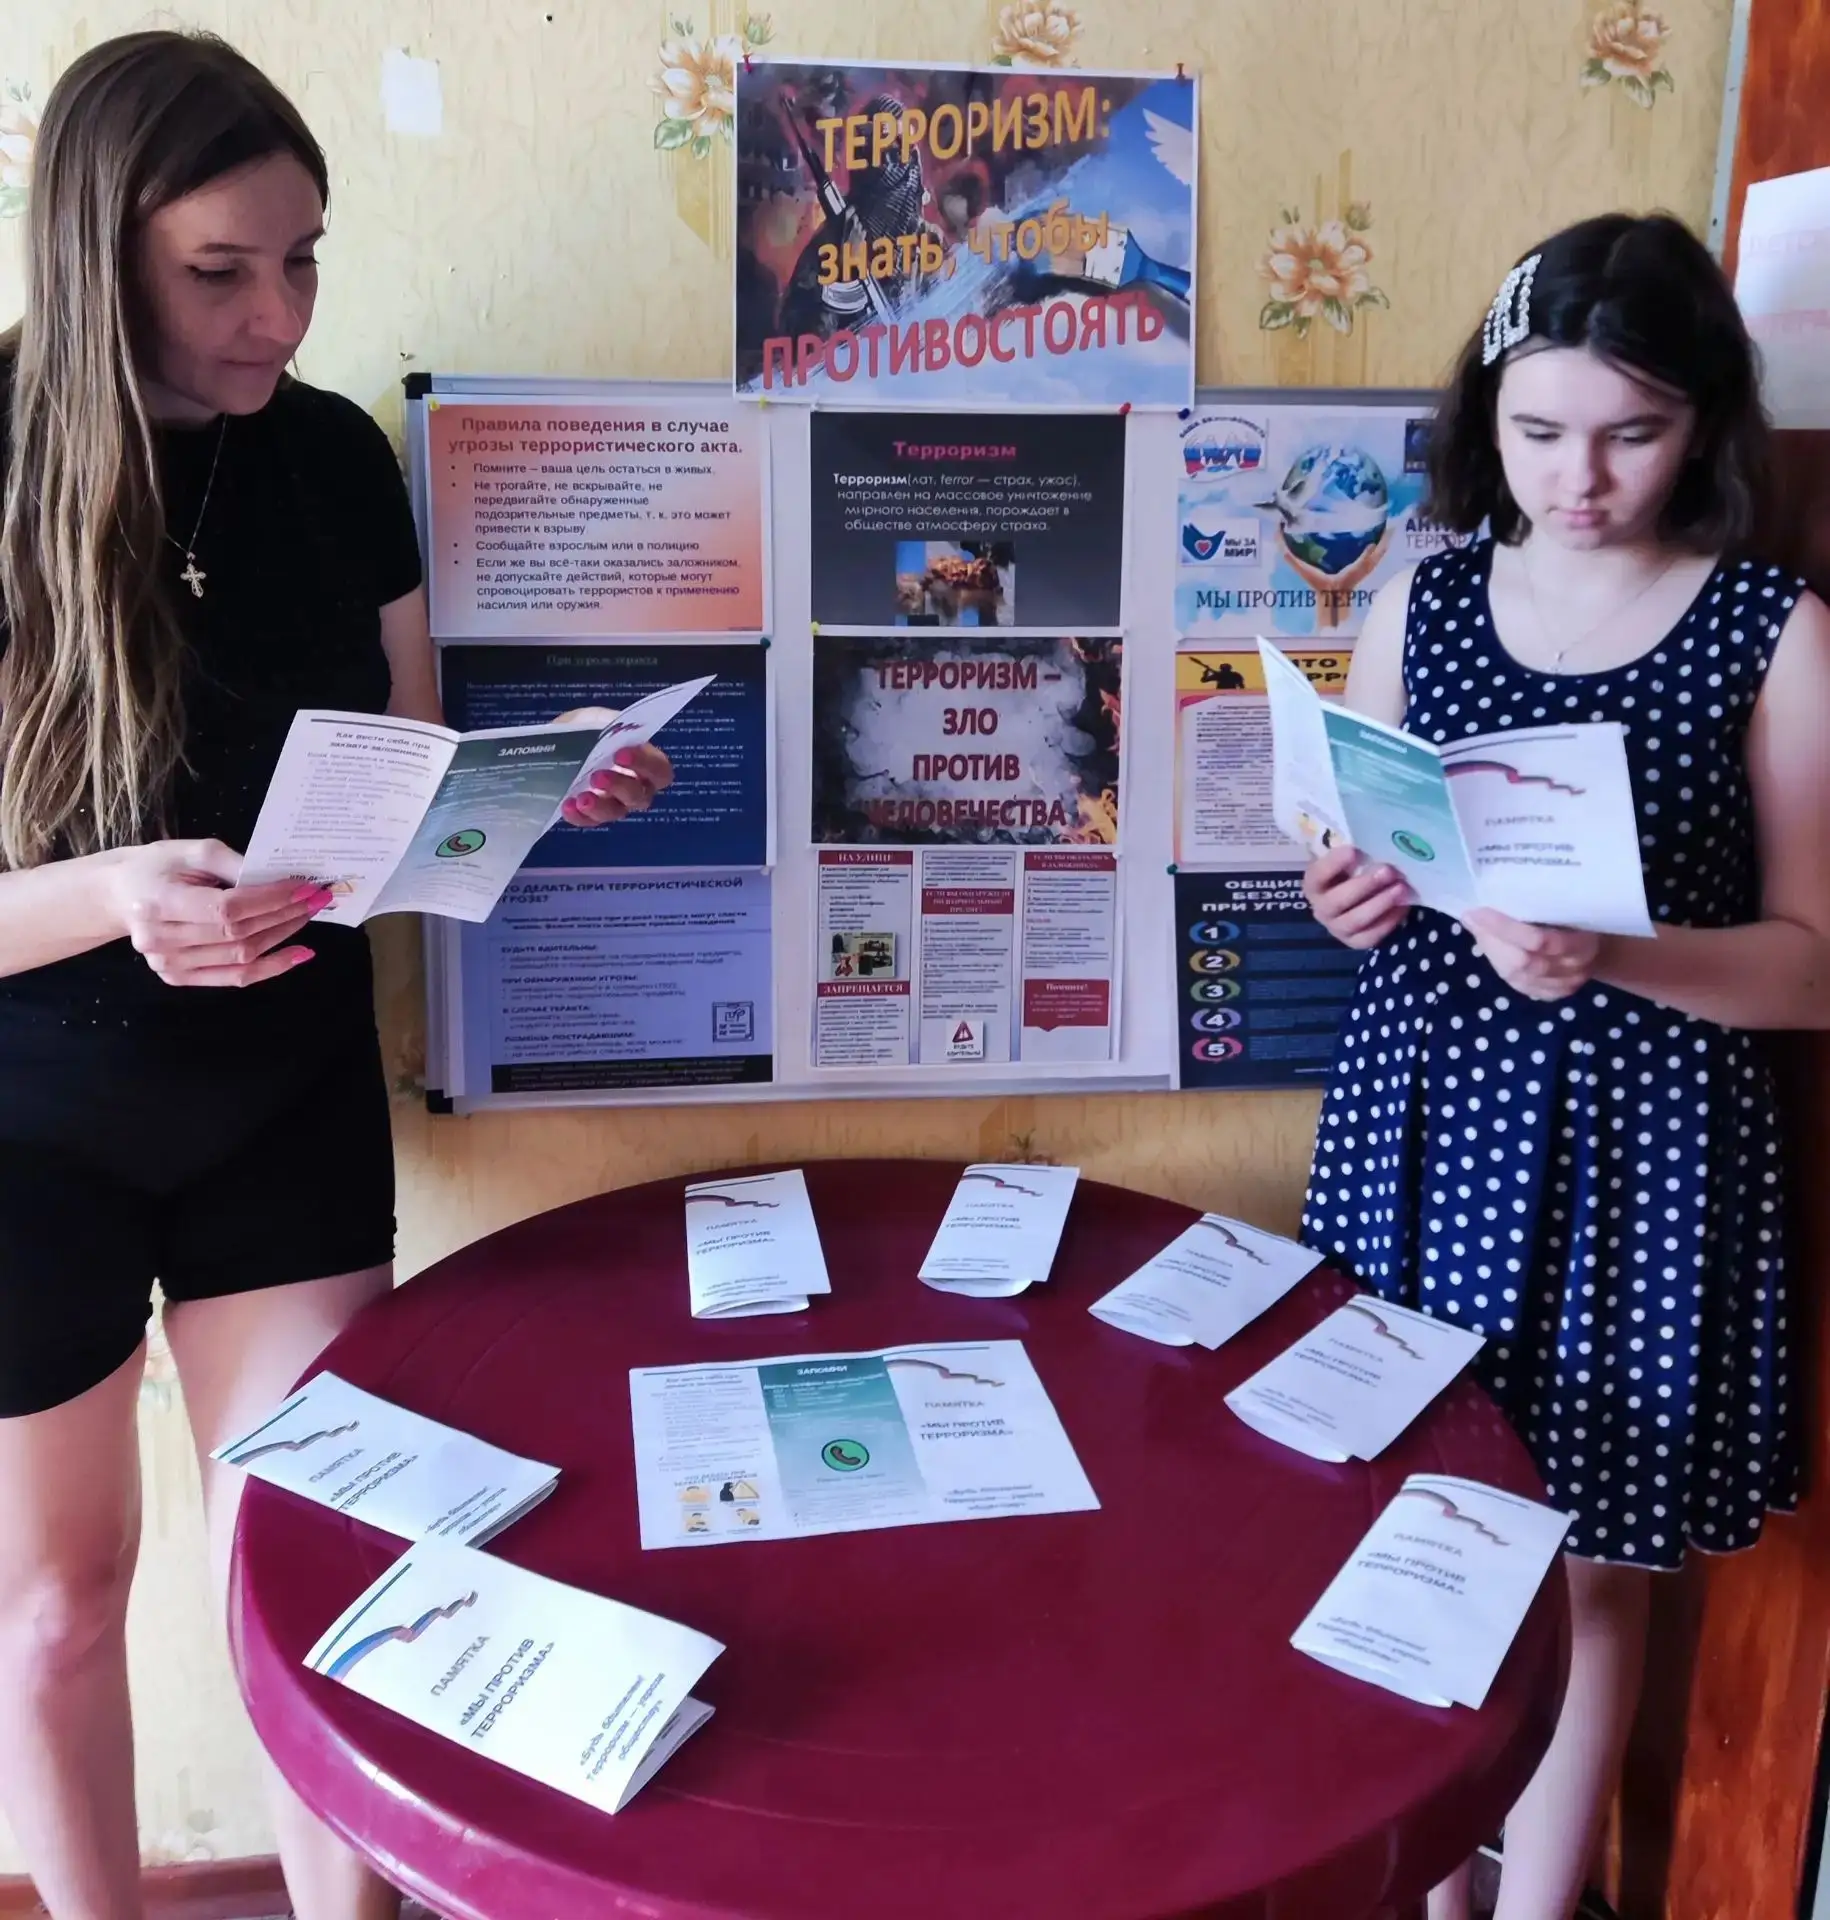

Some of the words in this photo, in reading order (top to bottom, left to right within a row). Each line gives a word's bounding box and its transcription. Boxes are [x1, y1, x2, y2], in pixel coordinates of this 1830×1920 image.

[816, 86, 1111, 172] ТЕРРОРИЗМ:
[817, 224, 958, 285] знать,
[968, 196, 1108, 264] чтобы
[762, 290, 1166, 389] ПРОТИВОСТОЯТЬ
[462, 418, 541, 434] Правила
[547, 420, 645, 434] поведения
[652, 422, 662, 431] в
[667, 421, 729, 435] случае
[448, 439, 513, 454] угрозы
[519, 440, 695, 454] террористического
[701, 442, 742, 453] акта.
[893, 441, 1016, 460] Терроризм
[473, 463, 526, 473] Помните
[576, 466, 605, 475] цель
[608, 466, 661, 474] остаться
[474, 482, 490, 490] Не
[495, 481, 550, 493] трогайте,
[554, 482, 568, 490] не
[649, 483, 663, 491] не
[474, 495, 557, 506] передвигайте
[560, 495, 649, 507] обнаруженные
[838, 490, 910, 501] направлен
[914, 491, 930, 500] на
[934, 491, 1004, 500] массовое
[1007, 492, 1092, 503] уничтожение
[475, 511, 575, 522] подозрительные
[671, 512, 691, 520] это
[695, 512, 731, 520] может
[844, 505, 904, 516] мирного
[907, 506, 982, 516] населения,
[986, 506, 1060, 517] порождает
[1063, 508, 1069, 516] в
[475, 524, 530, 535] привести
[844, 520, 912, 532] обществе
[916, 520, 997, 533] атмосферу
[476, 541, 545, 552] Сообщайте
[549, 543, 608, 553] взрослым
[1224, 538, 1241, 547] МЫ
[1224, 548, 1257, 558] МИР!
[476, 558, 506, 567] Если
[549, 558, 600, 567] всё-таки
[476, 574, 491, 582] не
[494, 572, 562, 583] допускайте
[566, 572, 625, 583] действий,
[628, 574, 677, 583] которые
[680, 574, 713, 583] могут
[477, 587, 575, 597] спровоцировать
[579, 587, 653, 597] террористов
[666, 587, 740, 597] применению
[477, 601, 527, 610] насилия
[531, 602, 552, 610] или
[1196, 590, 1232, 608] МЫ
[1236, 590, 1317, 608] ПРОТИВ
[877, 662, 1037, 690] ТЕРРОРИЗМ
[942, 708, 998, 735] ЗЛО
[498, 744, 557, 757] ЗАПОМНИ
[913, 754, 1020, 781] ПРОТИВ
[867, 799, 1067, 828] ЧЕЛОВЕЧЕСТВА
[523, 884, 574, 894] ДЕЛАТЬ
[577, 883, 604, 892] ПРИ
[609, 877, 743, 892] ТЕРРОРИСТИЧЕСКОЙ
[1202, 902, 1247, 911] ПРИ
[1253, 901, 1314, 911] УГРО
[1204, 927, 1219, 939] 1
[1206, 956, 1223, 968] 2
[824, 983, 903, 994] ЗАПРЕЩАЕТСЯ
[1206, 985, 1224, 997] 3
[1206, 1014, 1225, 1026] 4
[1208, 1043, 1225, 1056] 5
[1404, 1557, 1467, 1583] ПРОТИВ
[1357, 1560, 1464, 1595] ТЕРРОРИЗМА»
[431, 1636, 490, 1696] ПАМЯТКА
[460, 1693, 489, 1725] «МЫ
[485, 1638, 534, 1693] ПРОТИВ
[471, 1641, 555, 1738] ТЕРРОРИЗМА»
